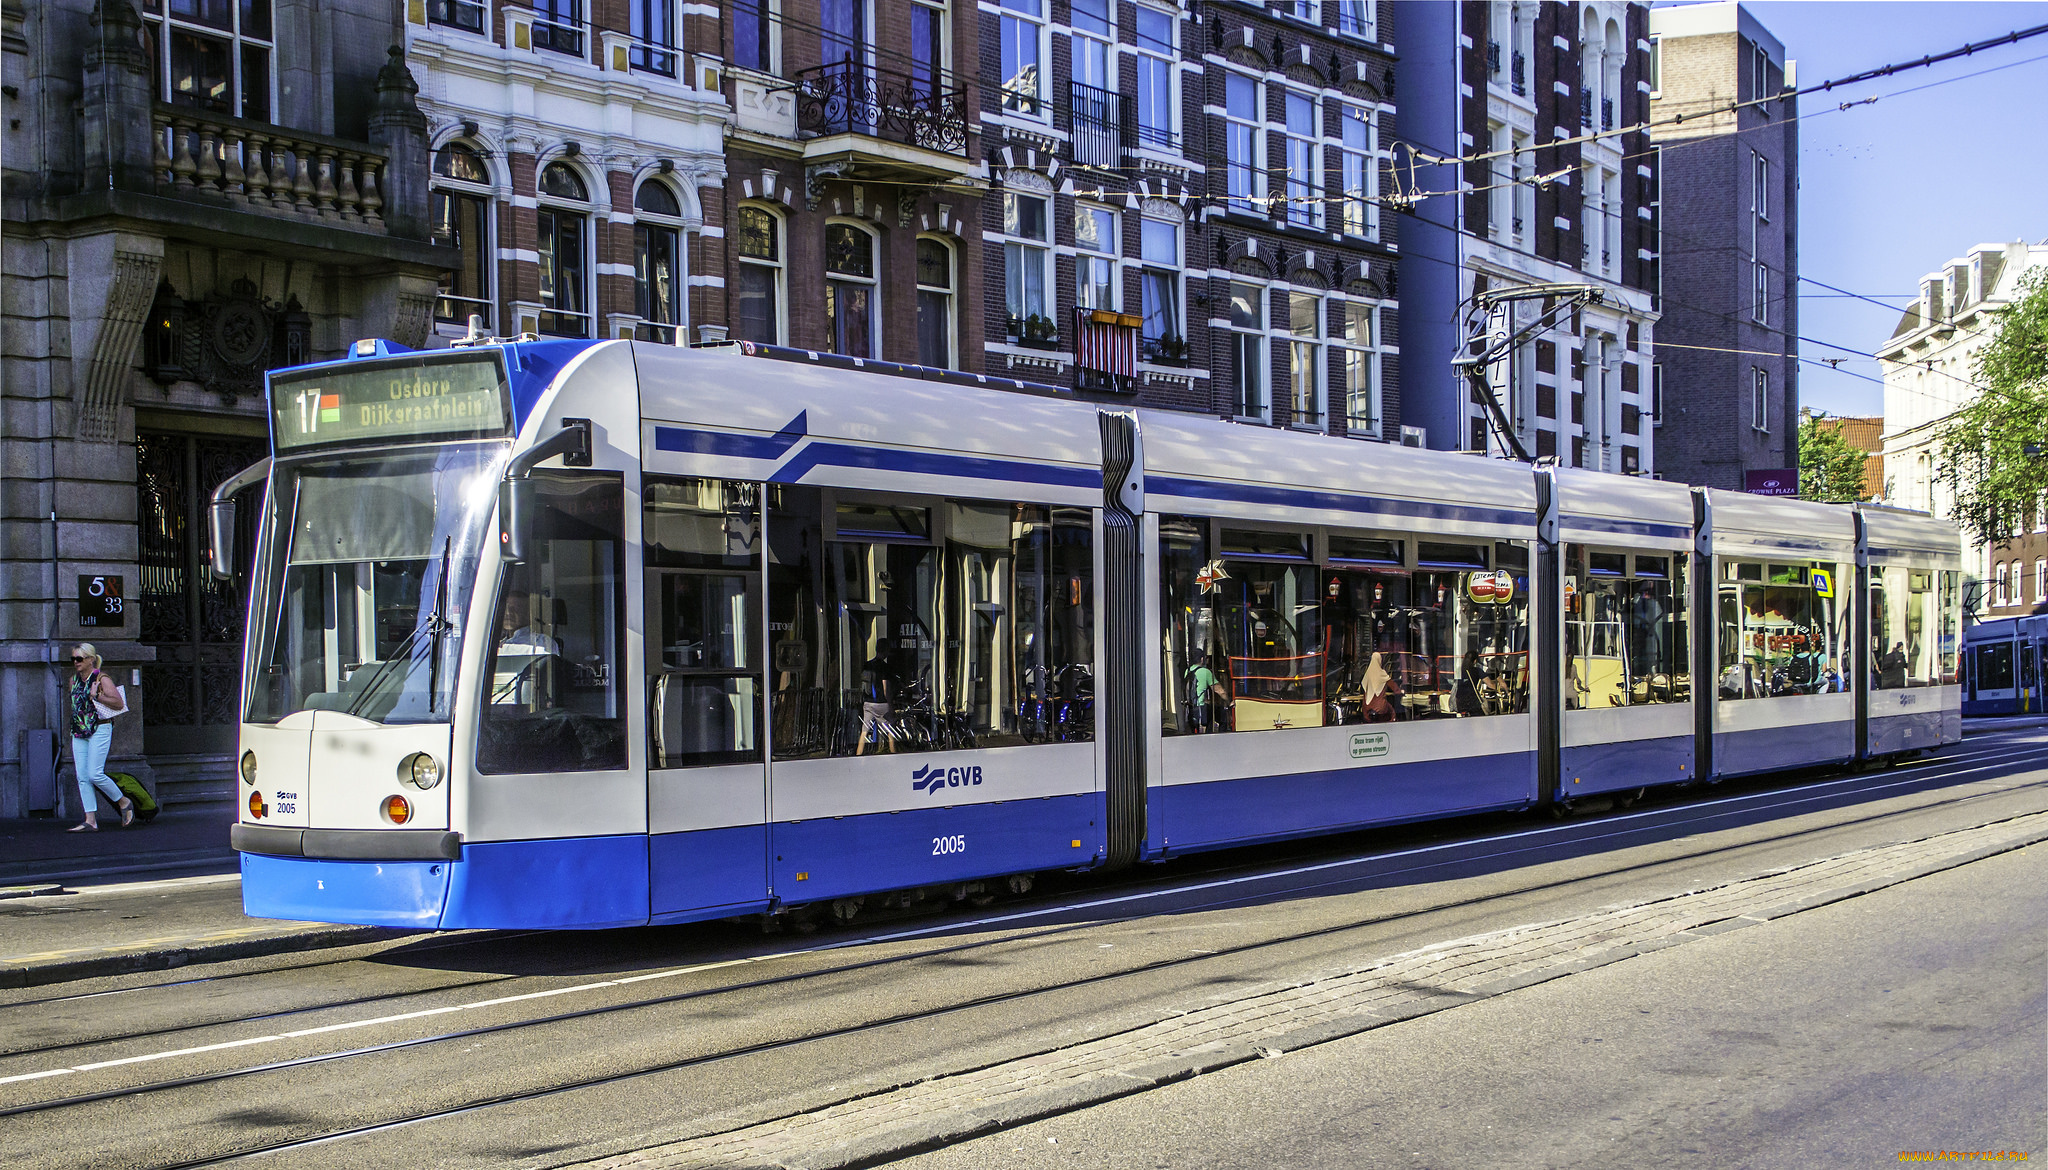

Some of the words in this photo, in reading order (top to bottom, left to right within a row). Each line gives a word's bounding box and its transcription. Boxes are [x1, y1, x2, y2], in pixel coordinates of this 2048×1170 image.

[389, 376, 451, 400] Osdorp
[296, 387, 322, 434] 17
[360, 394, 482, 427] Dijkgraafplein
[104, 596, 123, 614] 33
[947, 765, 983, 788] GVB
[286, 792, 298, 800] GVB
[277, 802, 296, 814] 2005
[932, 834, 966, 856] 2005
